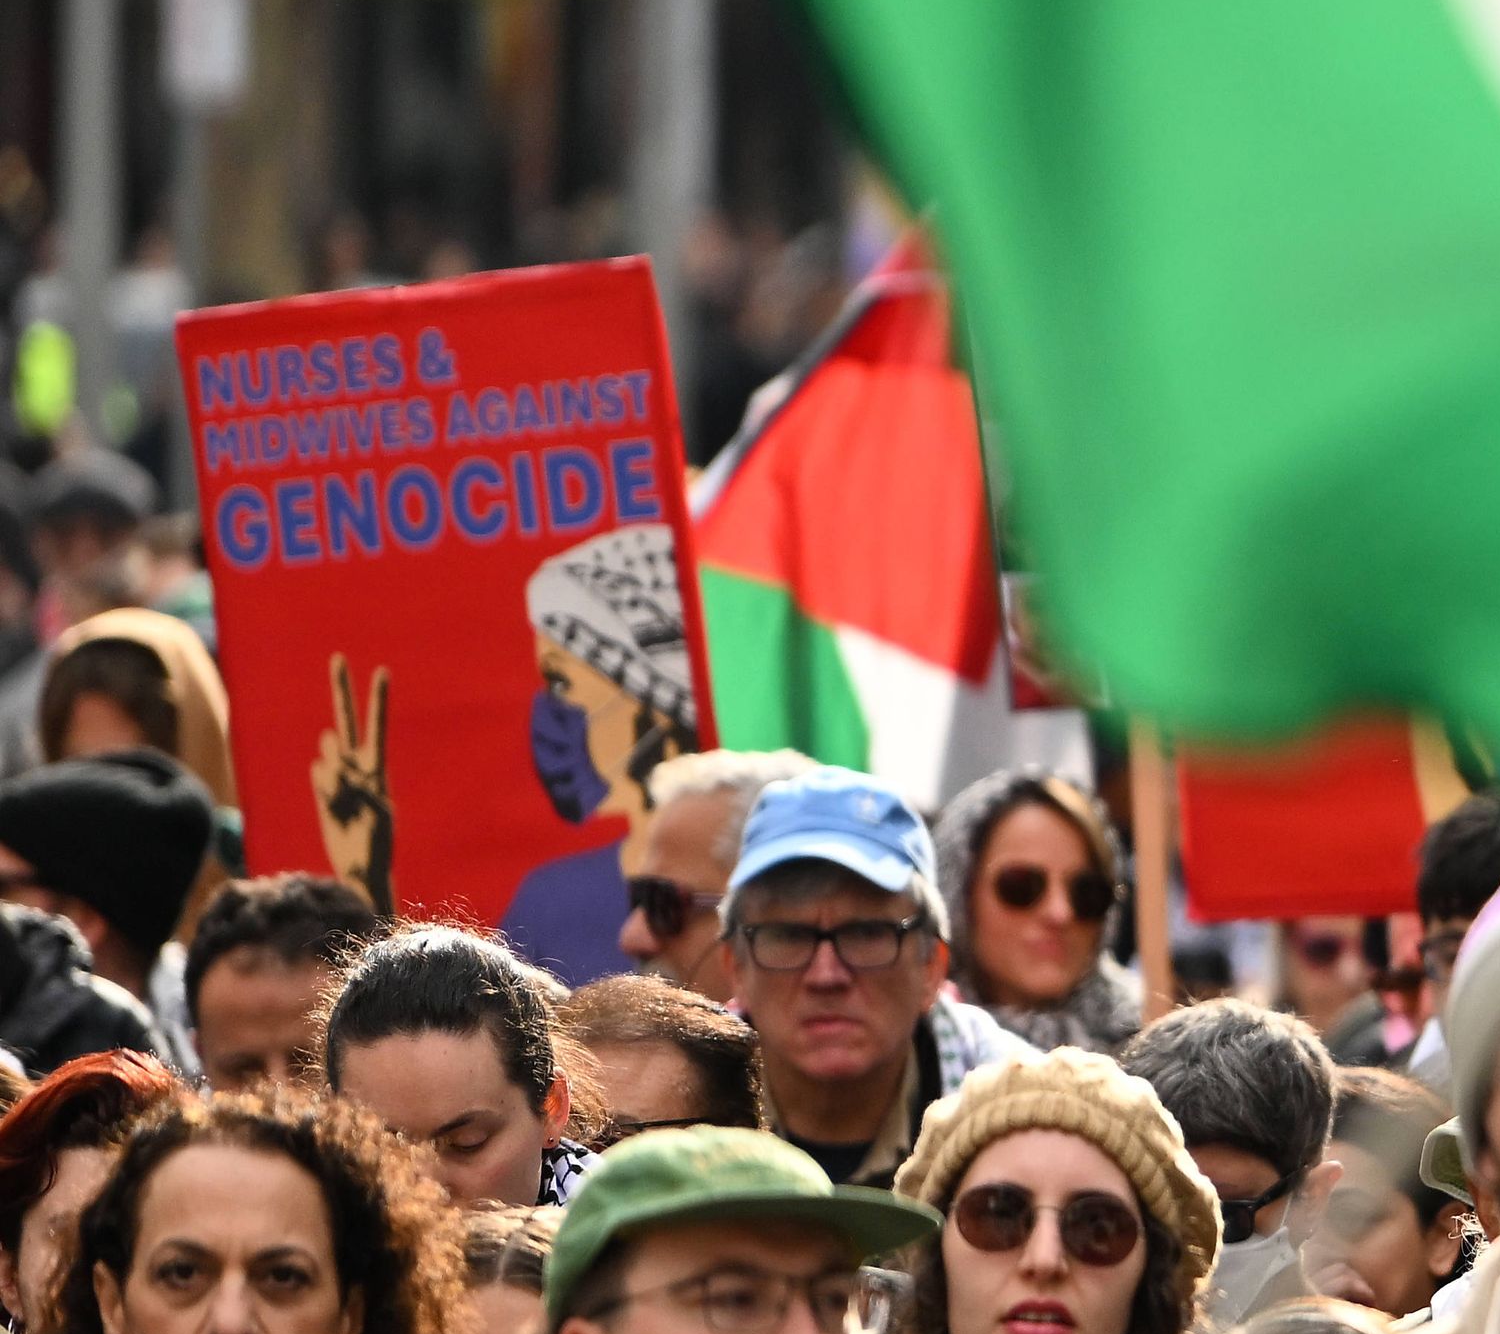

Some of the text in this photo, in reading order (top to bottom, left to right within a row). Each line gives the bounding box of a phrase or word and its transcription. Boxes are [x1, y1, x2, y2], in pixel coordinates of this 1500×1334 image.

[198, 328, 457, 410] NURSES &
[203, 371, 651, 469] MIDWIVES AGAINST
[217, 441, 661, 568] GENOCIDE
